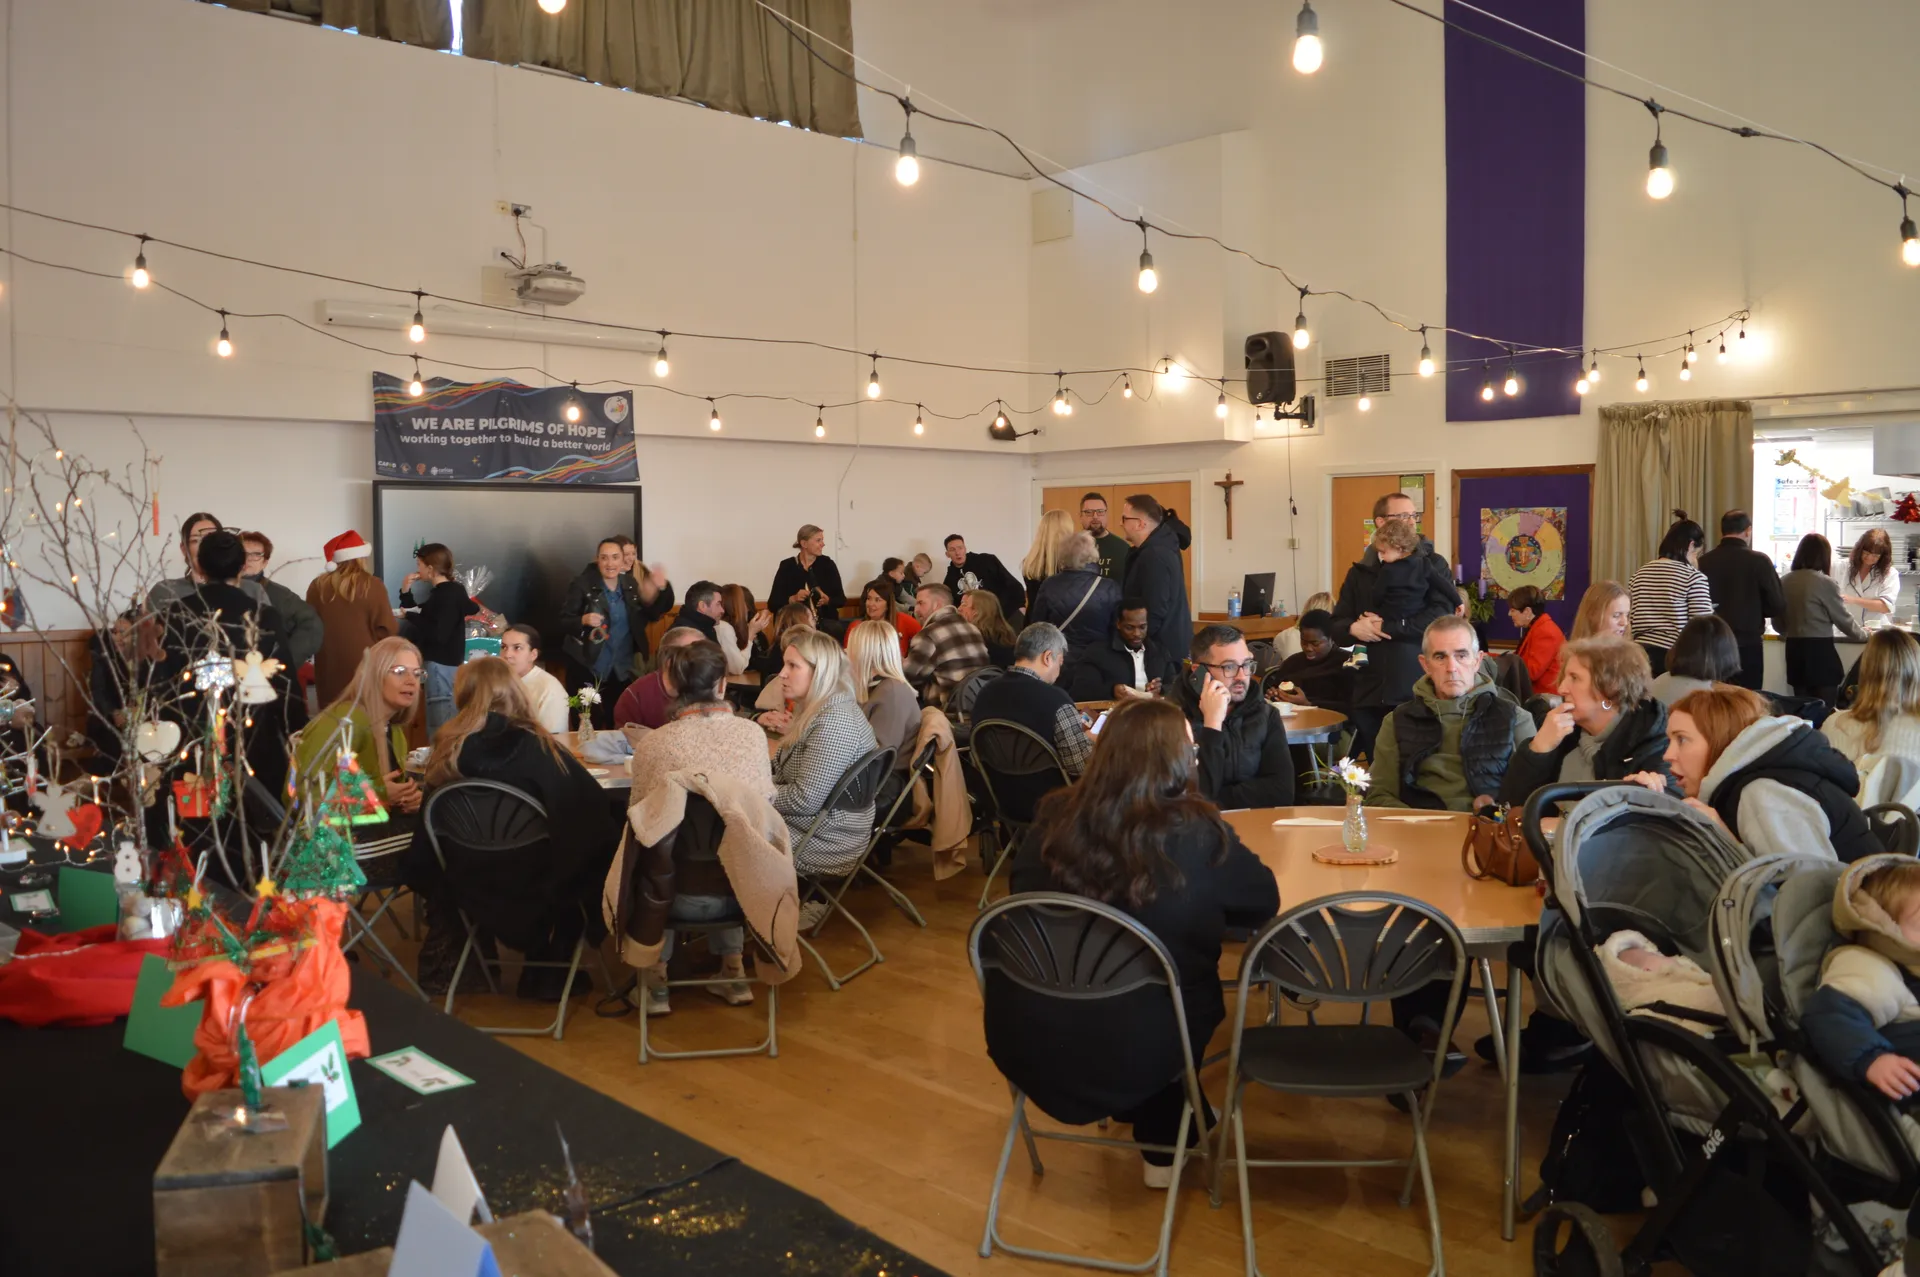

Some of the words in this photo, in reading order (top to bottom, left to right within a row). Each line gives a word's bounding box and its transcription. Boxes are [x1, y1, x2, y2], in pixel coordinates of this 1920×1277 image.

[412, 417, 439, 430] WE
[441, 417, 475, 430] ARE
[479, 417, 544, 434] PILGRIMS
[547, 423, 564, 435] OF
[568, 424, 606, 438] HOPE
[400, 434, 447, 446] working
[450, 434, 497, 446] together
[500, 434, 511, 443] to
[514, 434, 540, 447] build
[543, 440, 549, 448] a
[551, 439, 582, 449] better
[585, 442, 611, 451] world
[1702, 1128, 1725, 1159] Joie
